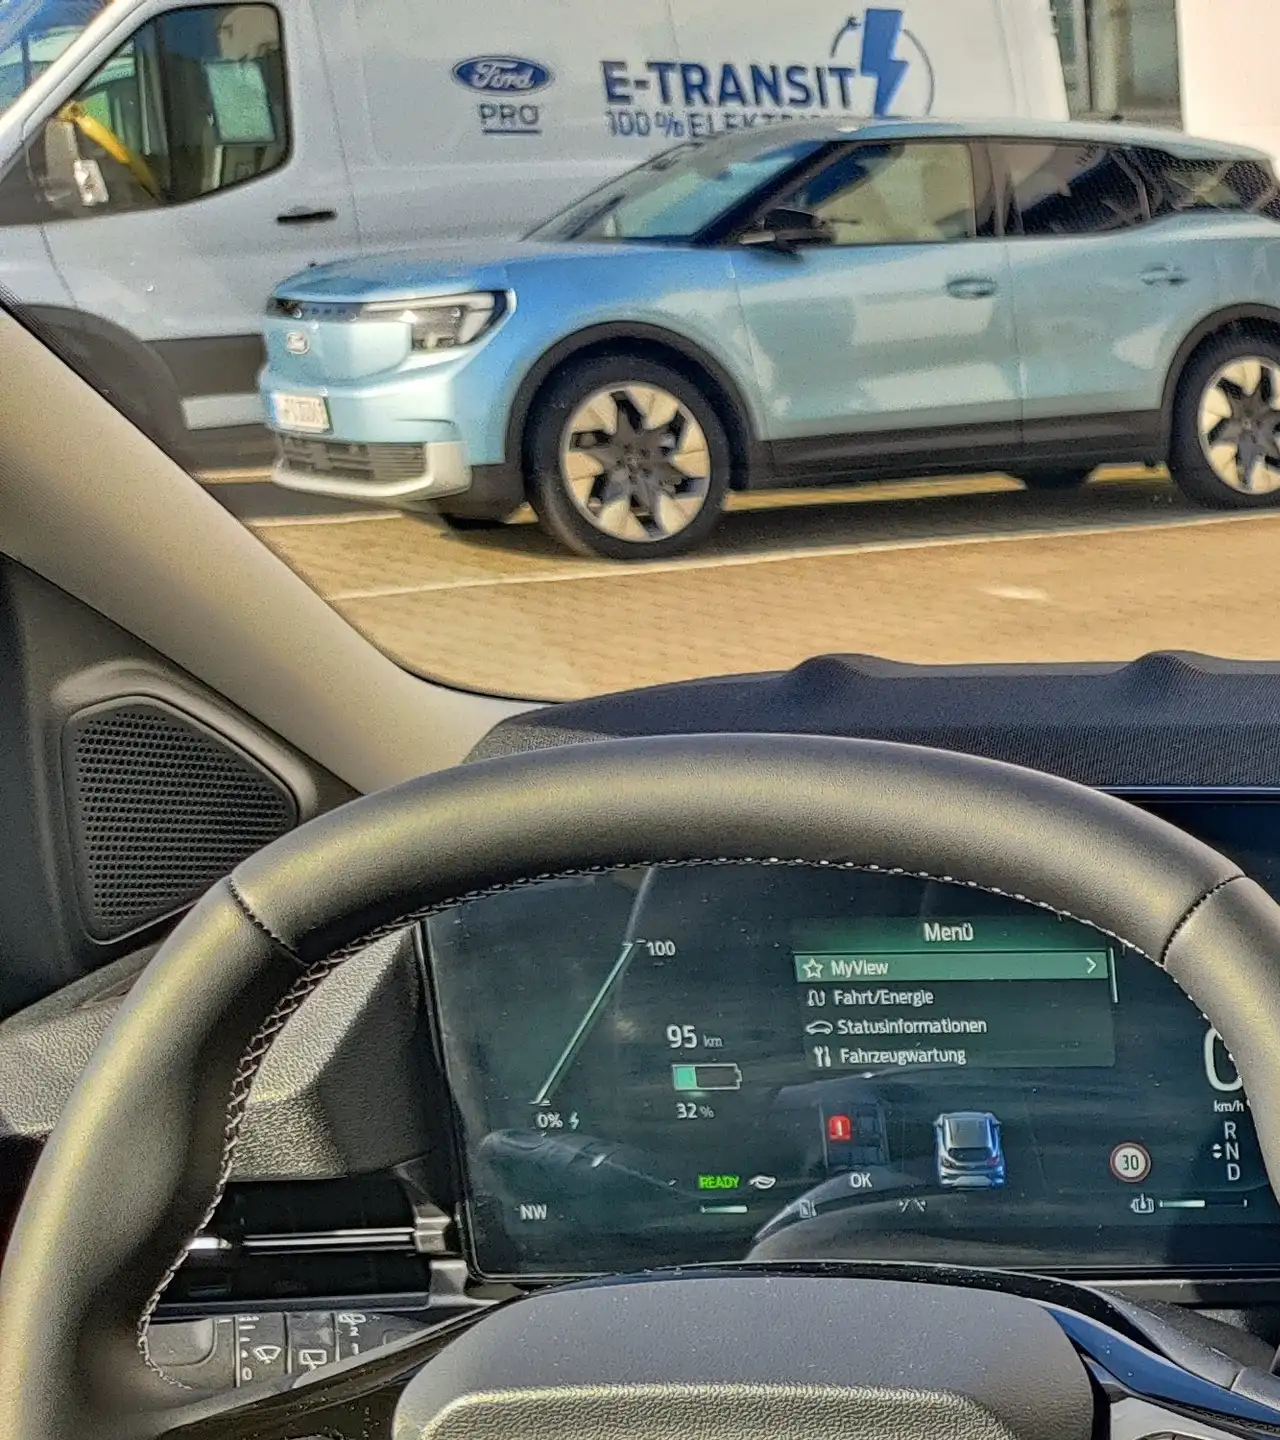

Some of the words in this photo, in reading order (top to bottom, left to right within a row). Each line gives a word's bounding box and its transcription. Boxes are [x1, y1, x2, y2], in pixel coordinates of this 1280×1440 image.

[473, 61, 535, 90] Ford
[600, 60, 856, 109] E-TRANSIT
[479, 103, 539, 125] PRO
[923, 922, 974, 942] Menü
[646, 940, 676, 956] 100
[831, 959, 889, 978] MyView
[834, 989, 935, 1007] Fahrt/Energie
[837, 1018, 988, 1035] Statusinformationen
[666, 1025, 698, 1049] 95
[703, 1034, 723, 1048] km
[840, 1048, 967, 1066] Fahrzeugwartung
[676, 1103, 698, 1119] 32
[1213, 1100, 1245, 1112] km/h
[536, 1113, 563, 1129] 0%
[1224, 1121, 1237, 1139] R
[1226, 1142, 1240, 1160] N
[1122, 1155, 1140, 1171] 30
[1227, 1163, 1241, 1181] D
[699, 1175, 740, 1189] READY
[849, 1173, 873, 1189] OK
[520, 1204, 548, 1220] NW
